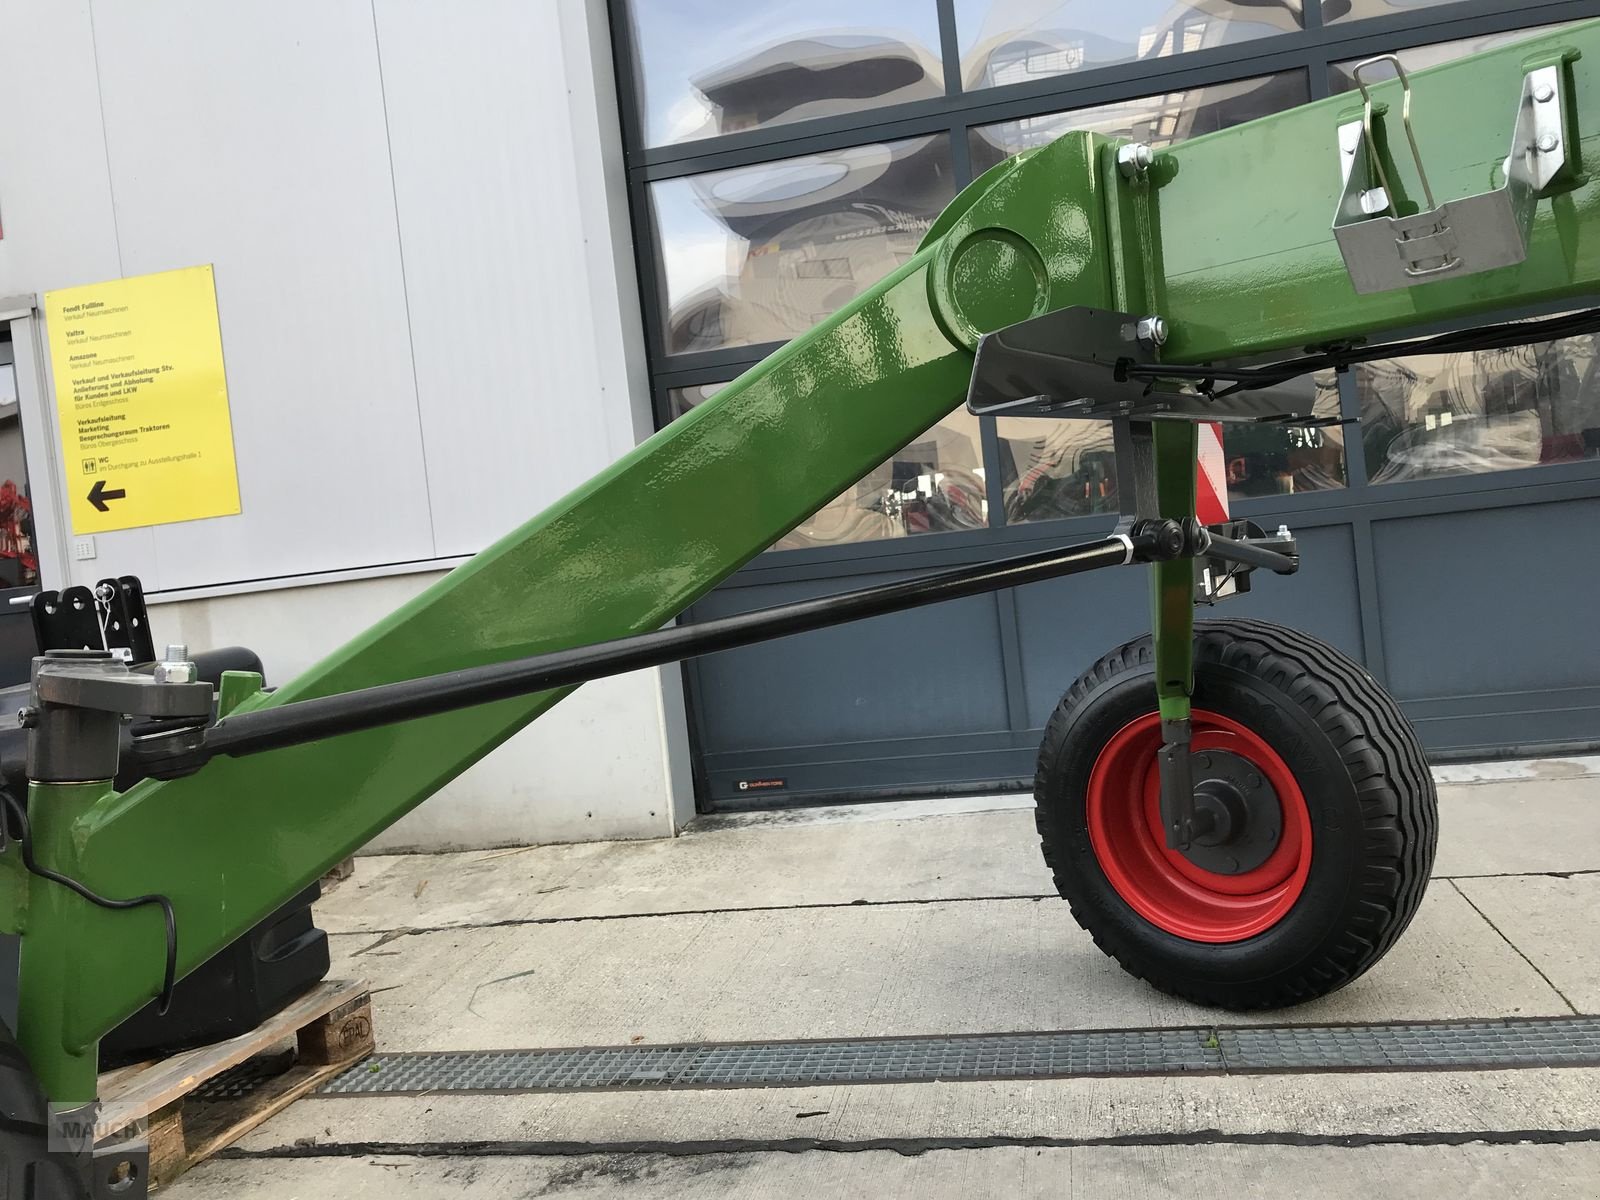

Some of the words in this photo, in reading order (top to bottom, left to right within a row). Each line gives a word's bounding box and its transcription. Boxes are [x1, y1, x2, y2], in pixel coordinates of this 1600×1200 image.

[63, 305, 80, 313] Fendt
[64, 312, 85, 321] Verkauf
[86, 306, 128, 316] Neumaschinen
[67, 337, 88, 345] Verkauf
[89, 330, 131, 341] Neumaschinen
[69, 353, 97, 361] Amazone
[70, 361, 91, 369] Verkauf
[92, 355, 134, 365] Neumaschinen
[72, 376, 96, 385] Verkauf
[110, 368, 160, 379] Verkaufsleitung
[74, 384, 109, 394] Anlieferung
[124, 377, 153, 387] Abholung
[85, 392, 108, 400] Kunden
[93, 398, 128, 407] Erdgeschoss
[77, 414, 126, 426] Verkaufsleitung
[79, 425, 109, 434] Marketing
[79, 429, 138, 442] Besprechungsraum
[139, 424, 170, 433] Traktoren
[98, 437, 138, 448] Obergeschoss
[108, 462, 139, 471] Durchgang
[148, 452, 198, 465] Ausstellungshalle
[343, 1021, 367, 1045] EPAL
